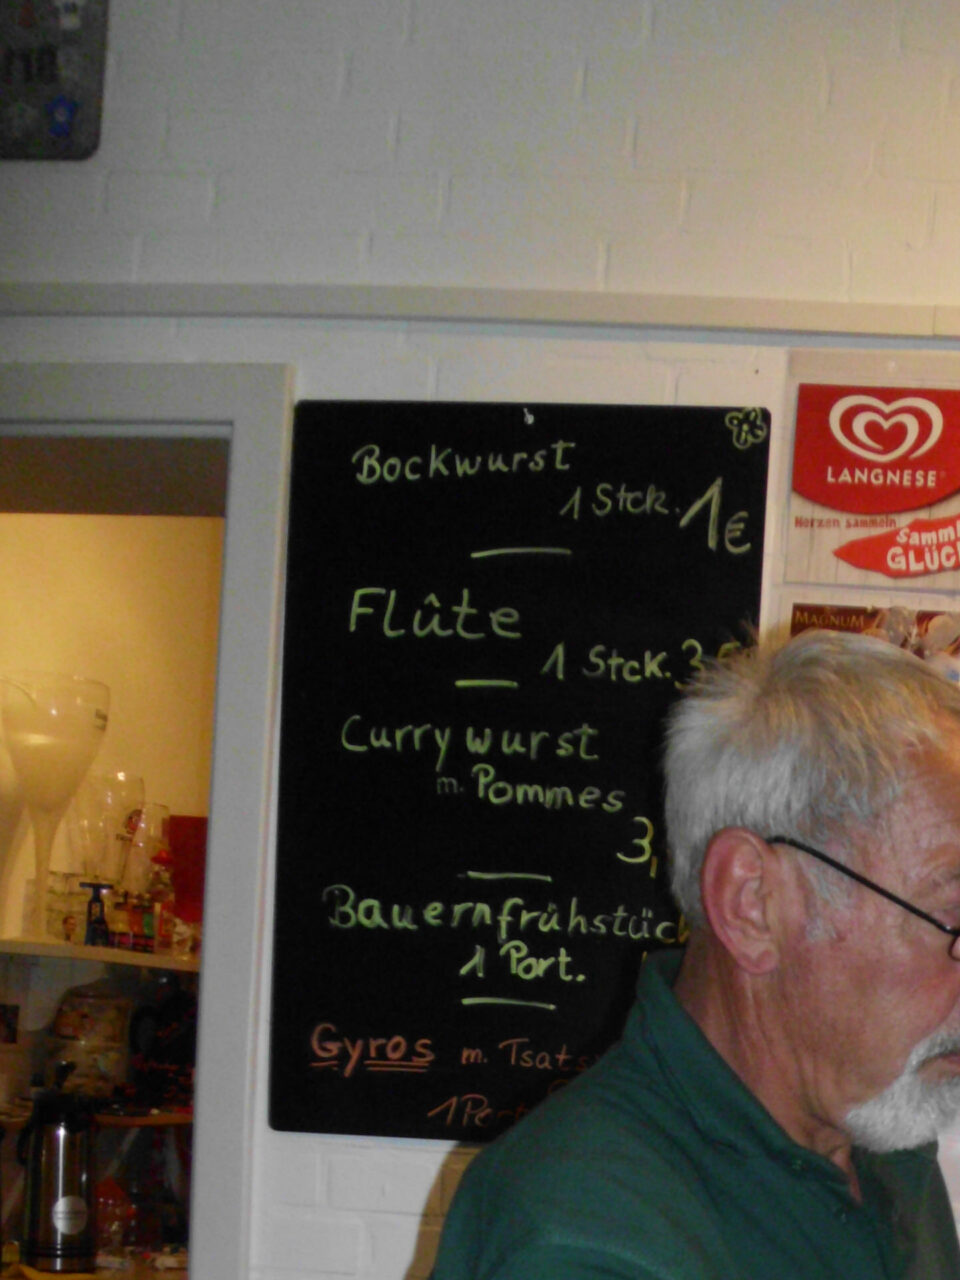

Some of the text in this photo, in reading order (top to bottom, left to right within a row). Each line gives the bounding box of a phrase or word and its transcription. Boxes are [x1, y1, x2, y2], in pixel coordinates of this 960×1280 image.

[352, 440, 576, 484] Bockwurst
[827, 465, 937, 488] LANGNESE
[559, 486, 582, 520] 1
[794, 515, 897, 529] Herzen sammeln
[349, 587, 522, 640] Flûte
[541, 642, 564, 681] 1
[472, 763, 625, 813] Pommes
[459, 945, 484, 978] 1
[310, 1023, 434, 1077] Gyros
